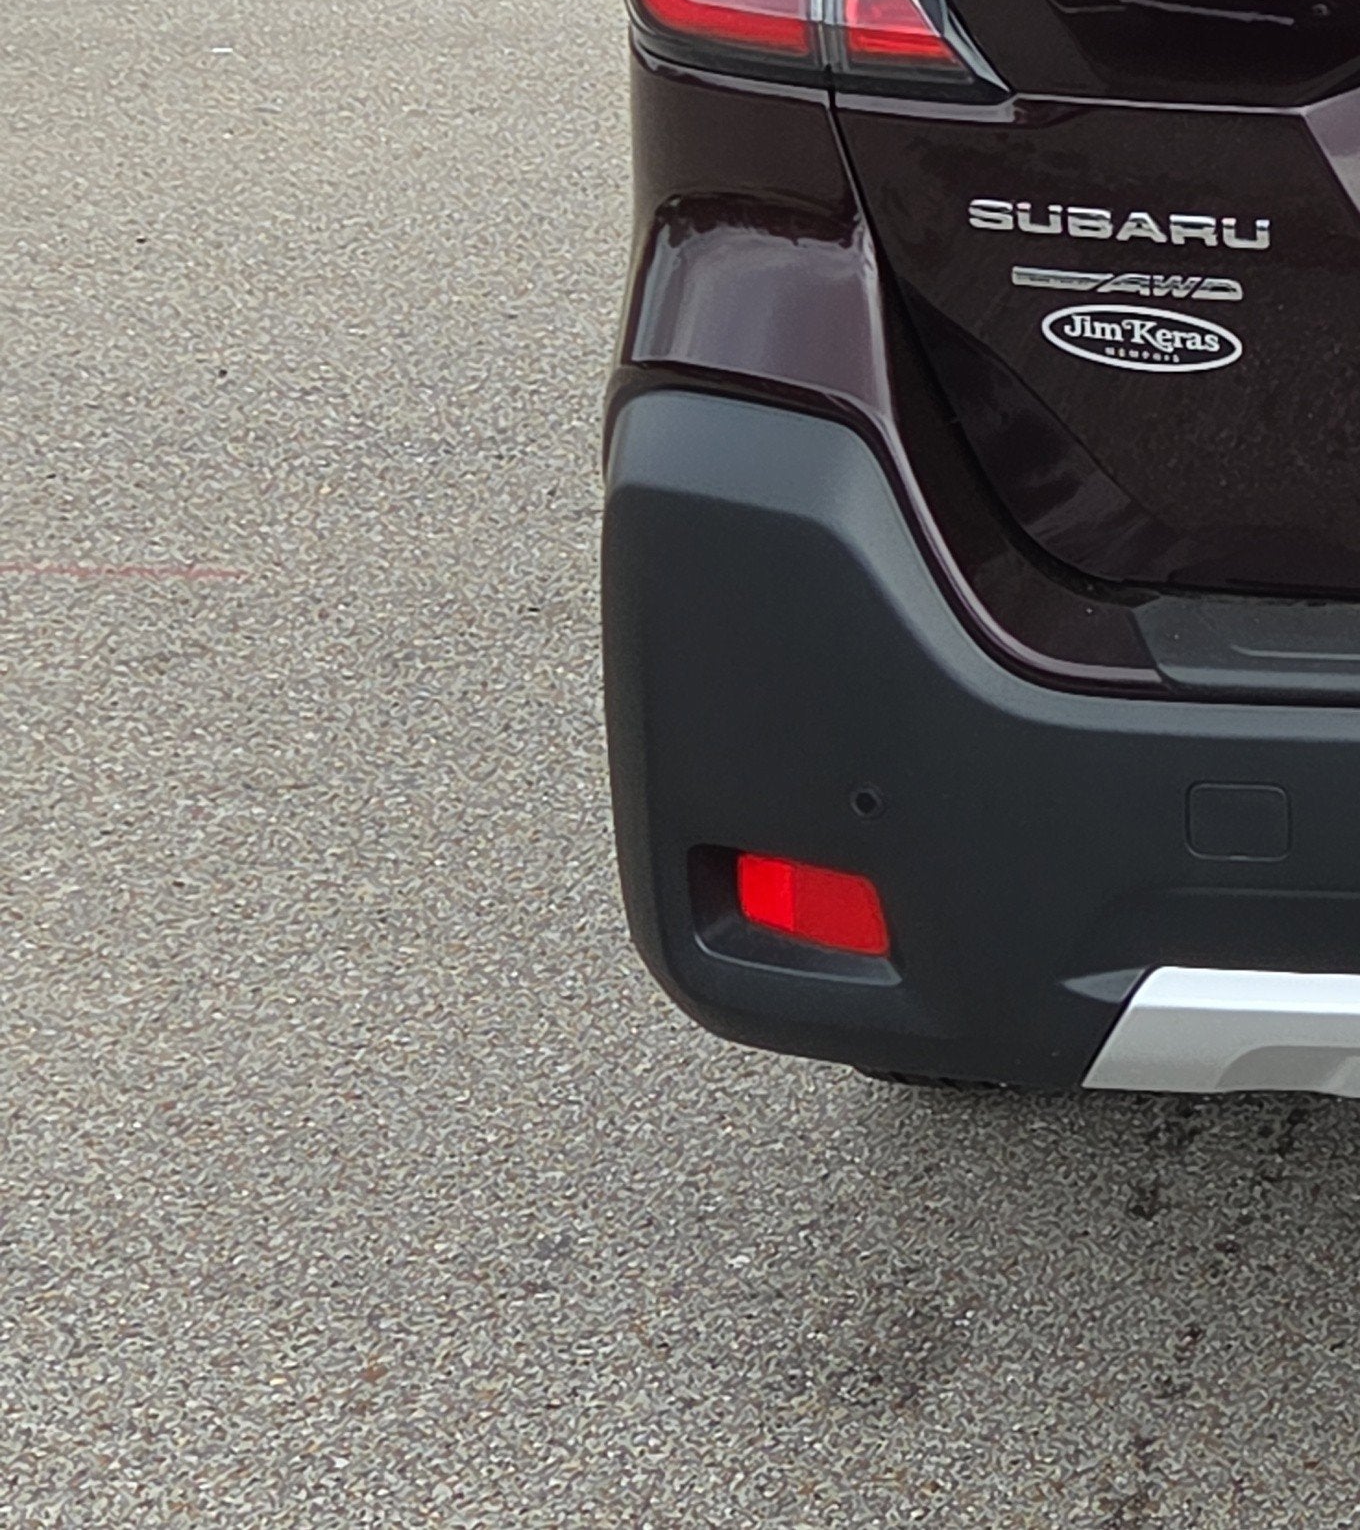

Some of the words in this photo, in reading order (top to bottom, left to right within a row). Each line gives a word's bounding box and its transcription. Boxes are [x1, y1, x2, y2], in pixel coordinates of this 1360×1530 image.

[968, 199, 1270, 250] SUBARU
[1096, 273, 1244, 301] AWD
[1063, 315, 1124, 343] Jim
[1122, 319, 1221, 353] Keras
